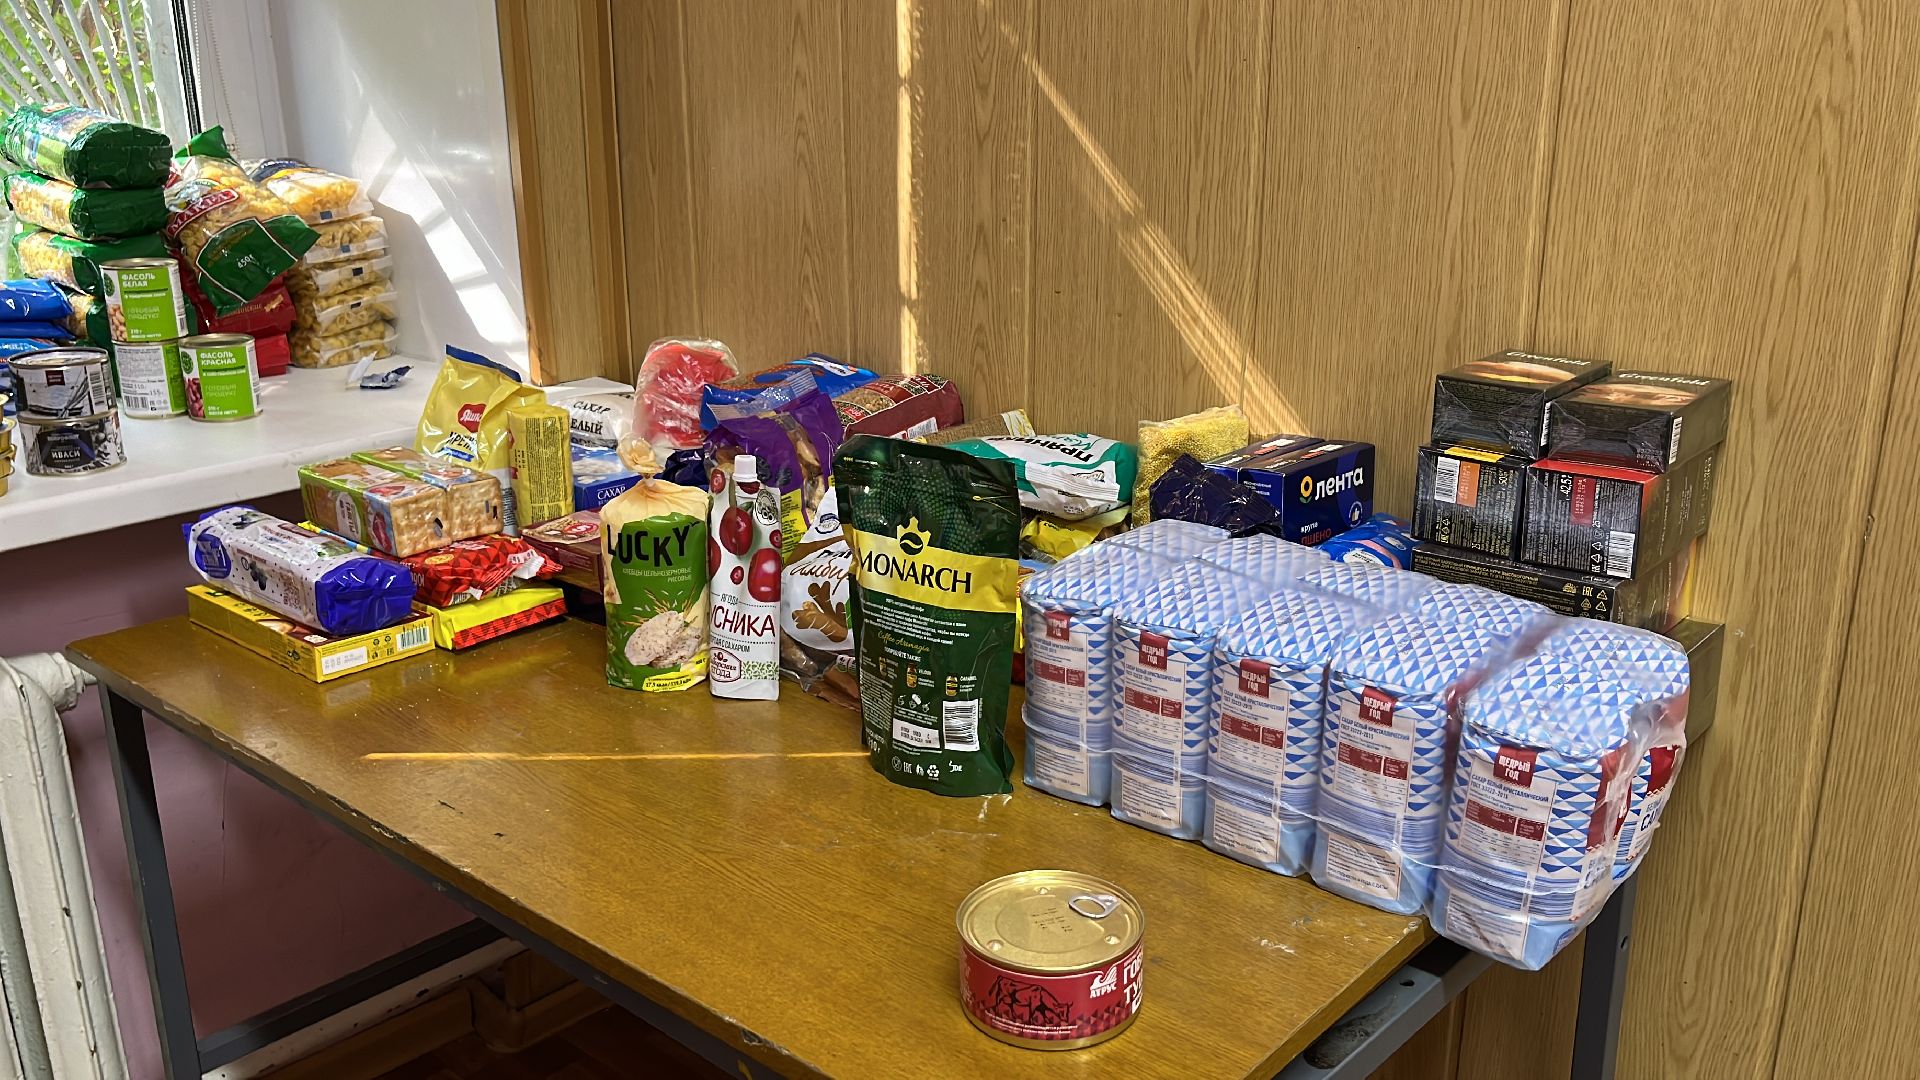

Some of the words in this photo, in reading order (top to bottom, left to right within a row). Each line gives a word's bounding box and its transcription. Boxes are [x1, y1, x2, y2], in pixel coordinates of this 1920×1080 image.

[200, 351, 234, 359] ФАСОЛЬ
[1506, 351, 1591, 366] Greenfield
[1619, 373, 1710, 386] Greenfield
[573, 400, 611, 414] САХАР
[51, 450, 80, 459] ИВАСИ
[1315, 467, 1364, 500] лента
[597, 486, 626, 500] САХАР
[1300, 522, 1318, 533] крупа
[1301, 528, 1331, 546] ПШЕНО
[607, 524, 690, 567] LUCKY
[860, 548, 972, 593] MONARCH
[720, 594, 739, 605] ЯГОДА
[1141, 644, 1165, 657] ЩЕДРЫЙ
[1147, 654, 1158, 664] ГОД
[1241, 670, 1267, 684] ЩЕДРЫЙ
[1248, 681, 1259, 692] ГОД
[1363, 696, 1392, 712] ЩЕДРЫЙ
[1369, 708, 1381, 720] ГОД
[1499, 755, 1531, 772] ЩЕДРЫЙ
[1505, 768, 1519, 780] ГОД
[1503, 784, 1549, 802] КРИСТАЛЛИЧЕСКИЙ
